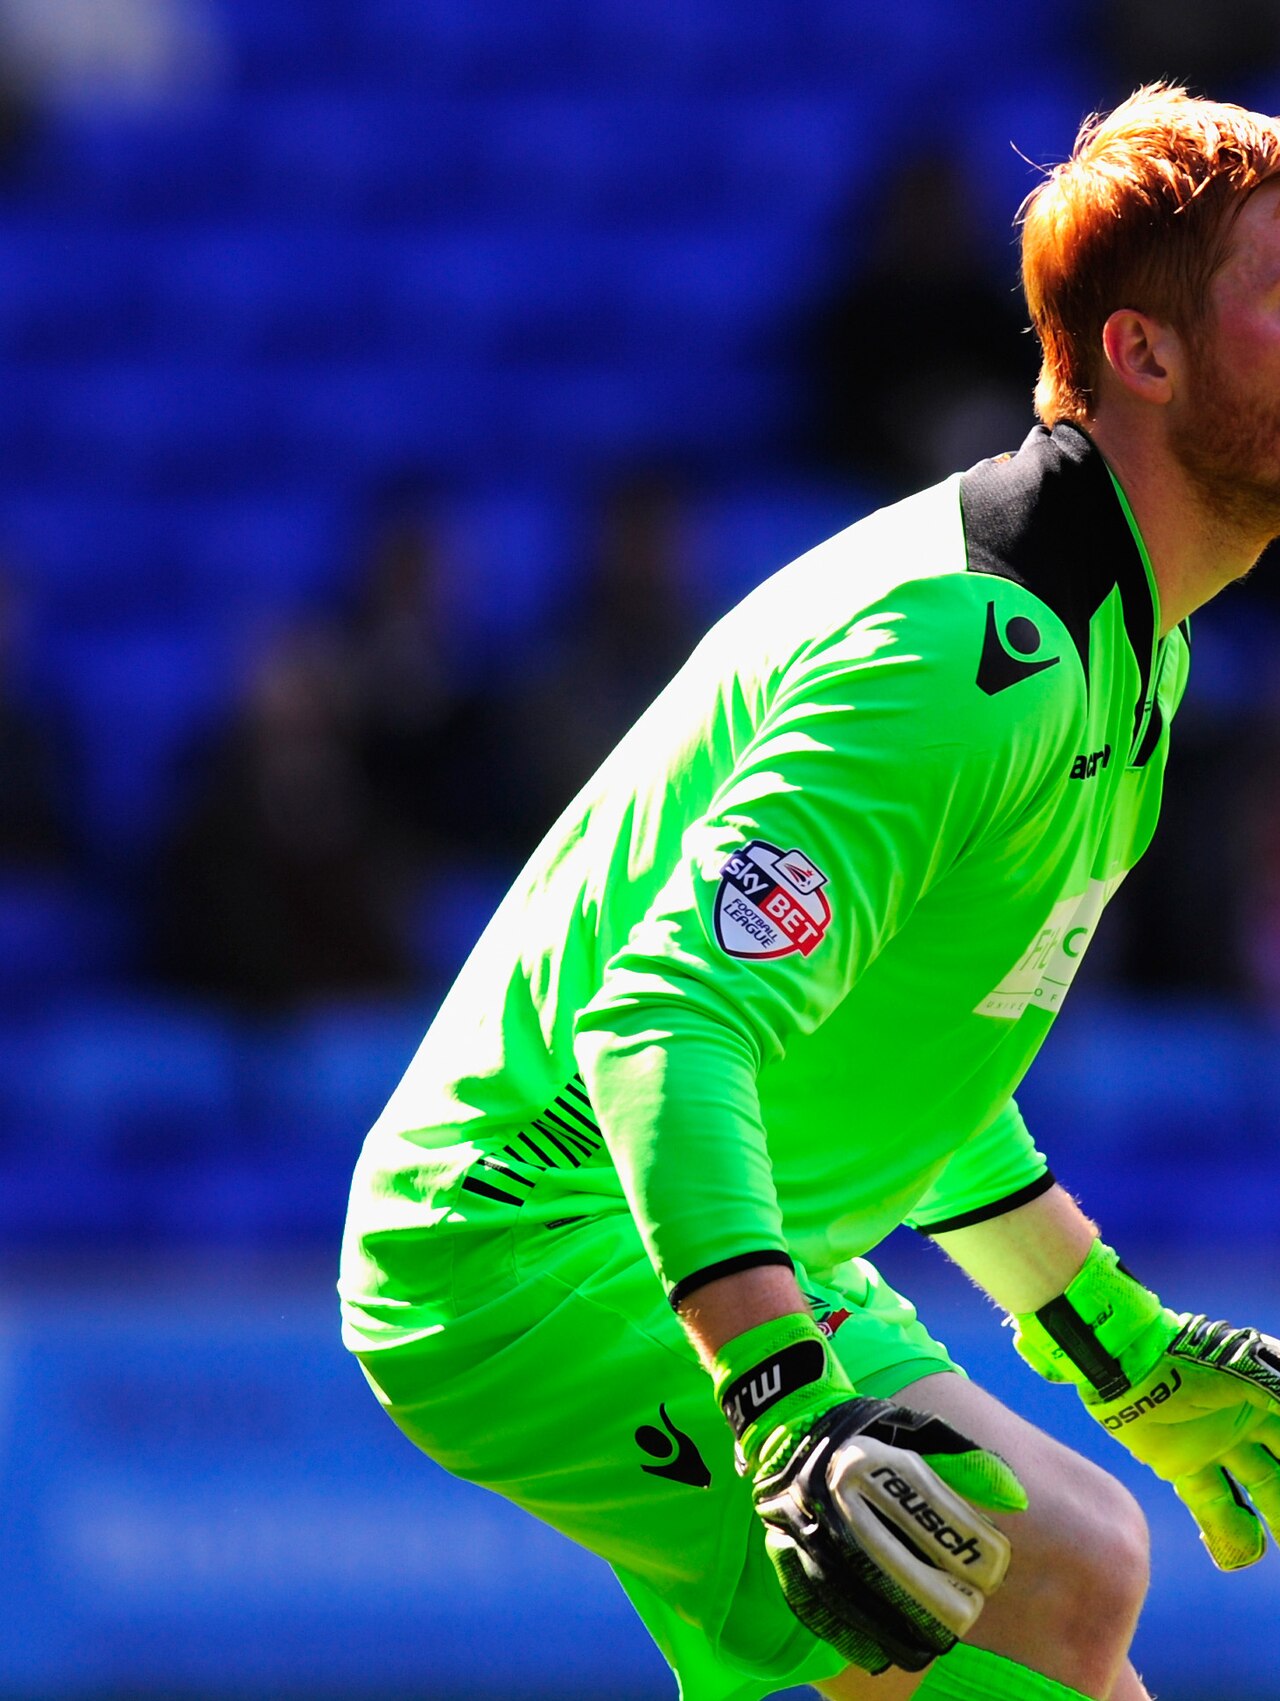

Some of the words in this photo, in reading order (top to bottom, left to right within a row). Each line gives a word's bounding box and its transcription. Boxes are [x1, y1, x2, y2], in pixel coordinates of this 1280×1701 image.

[723, 904, 773, 949] LEAGUE
[725, 858, 769, 895] sky
[765, 893, 818, 943] BET
[732, 898, 778, 942] FOOTBALL
[1101, 1368, 1182, 1434] reusc
[870, 1467, 982, 1565] reusch
